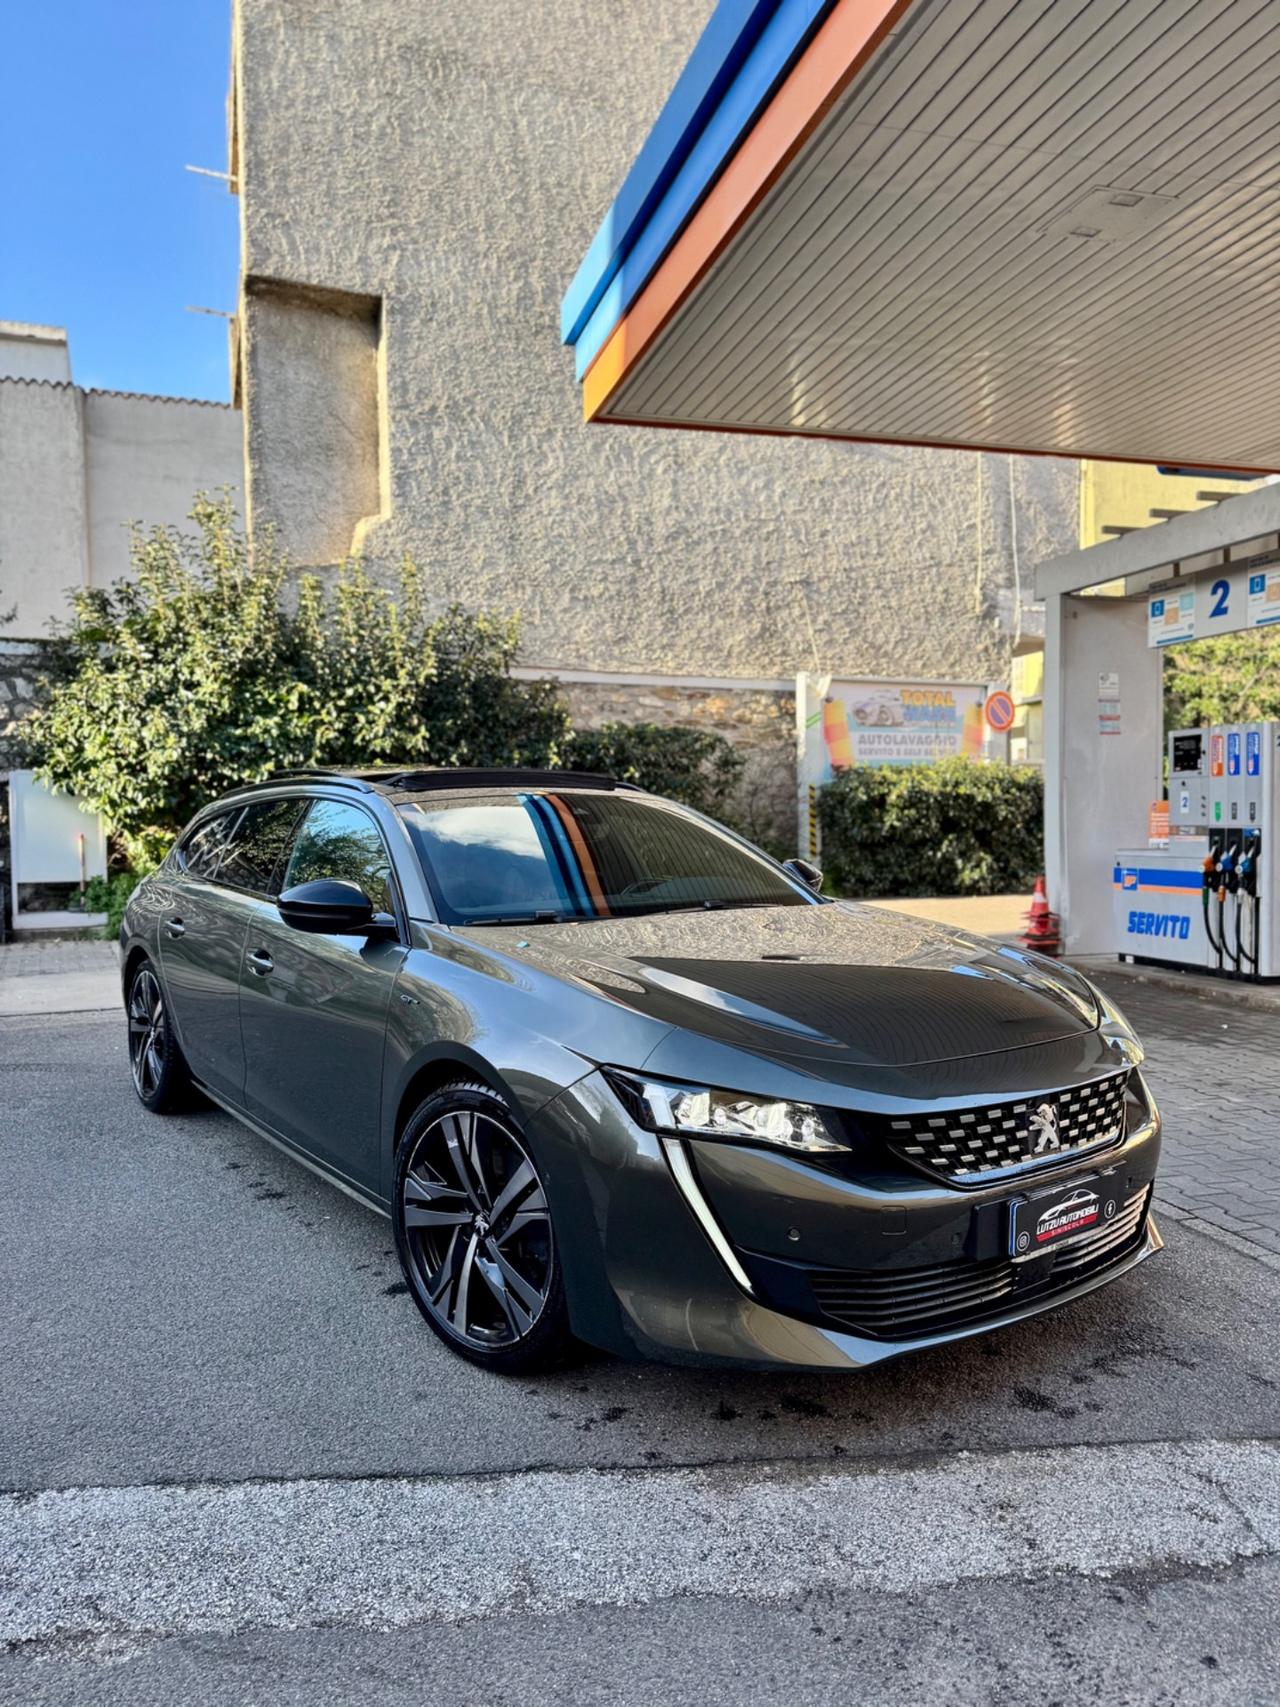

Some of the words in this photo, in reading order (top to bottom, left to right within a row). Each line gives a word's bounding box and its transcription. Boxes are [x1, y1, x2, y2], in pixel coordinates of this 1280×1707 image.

[1209, 579, 1230, 618] 2
[900, 689, 956, 707] TOTAL
[858, 734, 957, 746] AUTOLAVAGGIO
[858, 748, 894, 756] SERVITO
[1182, 797, 1189, 808] 2
[1128, 911, 1190, 939] SERVITO
[1036, 1217, 1060, 1235] LUTZU
[1060, 1203, 1099, 1226] AUTOMOBILI
